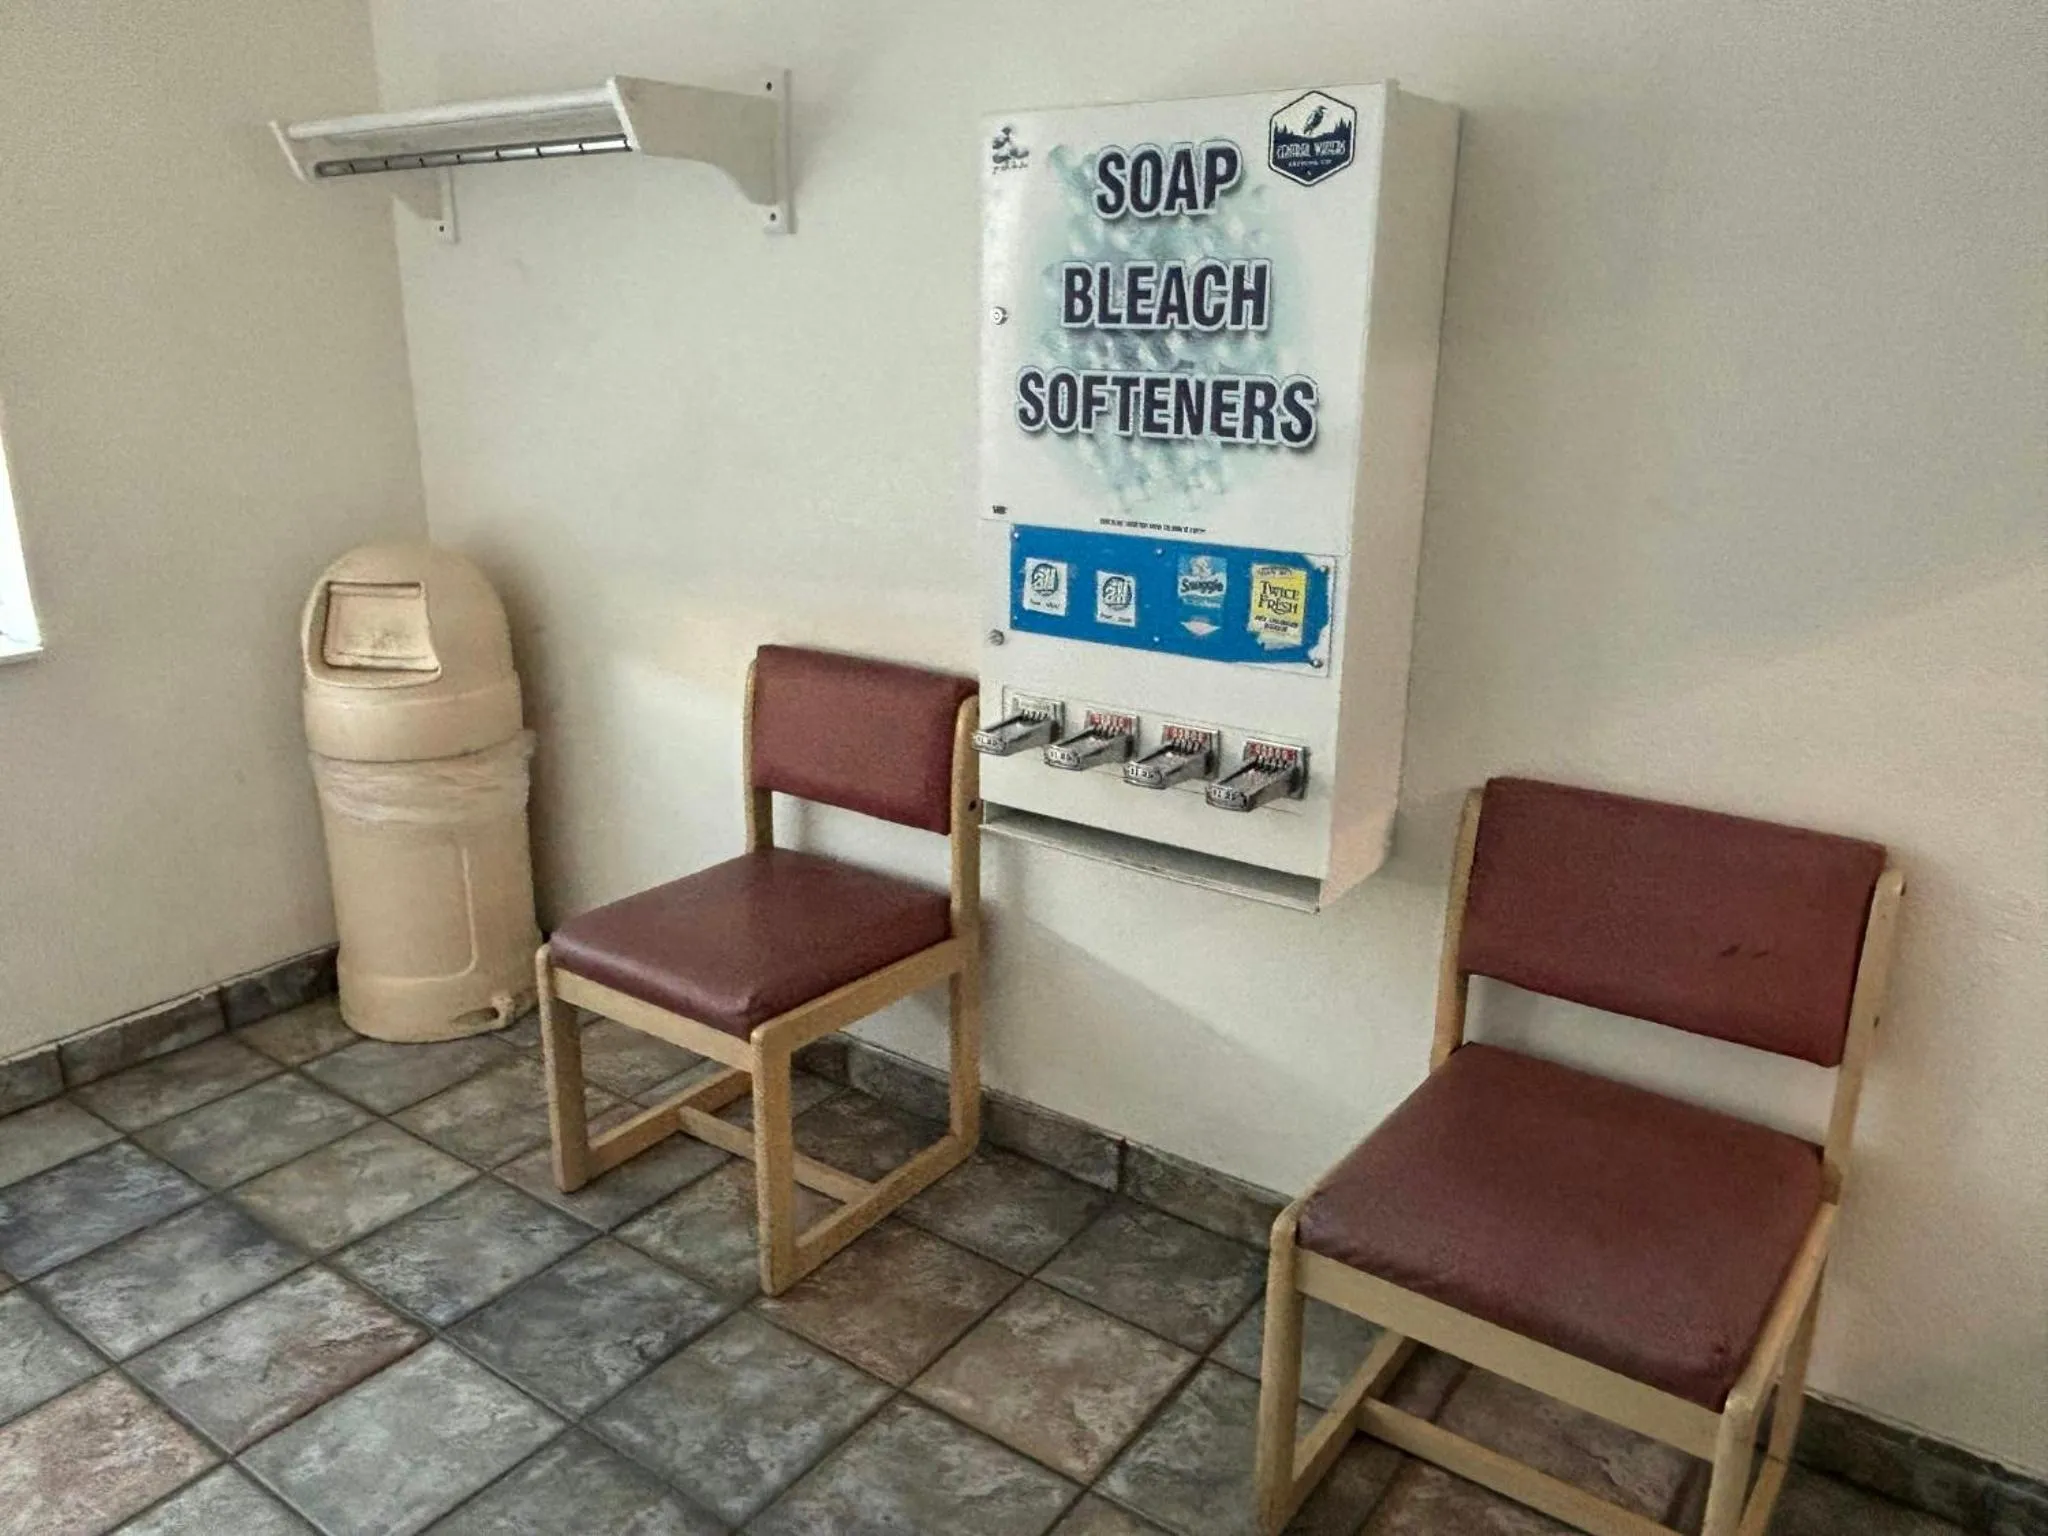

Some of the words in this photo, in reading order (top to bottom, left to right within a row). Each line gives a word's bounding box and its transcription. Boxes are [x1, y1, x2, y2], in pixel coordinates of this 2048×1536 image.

[1094, 144, 1240, 217] SOAP
[1061, 261, 1270, 329] BLEACH
[1015, 369, 1317, 446] SOFTENERS
[1258, 594, 1298, 615] FRESH
[1260, 580, 1300, 600] TWICE
